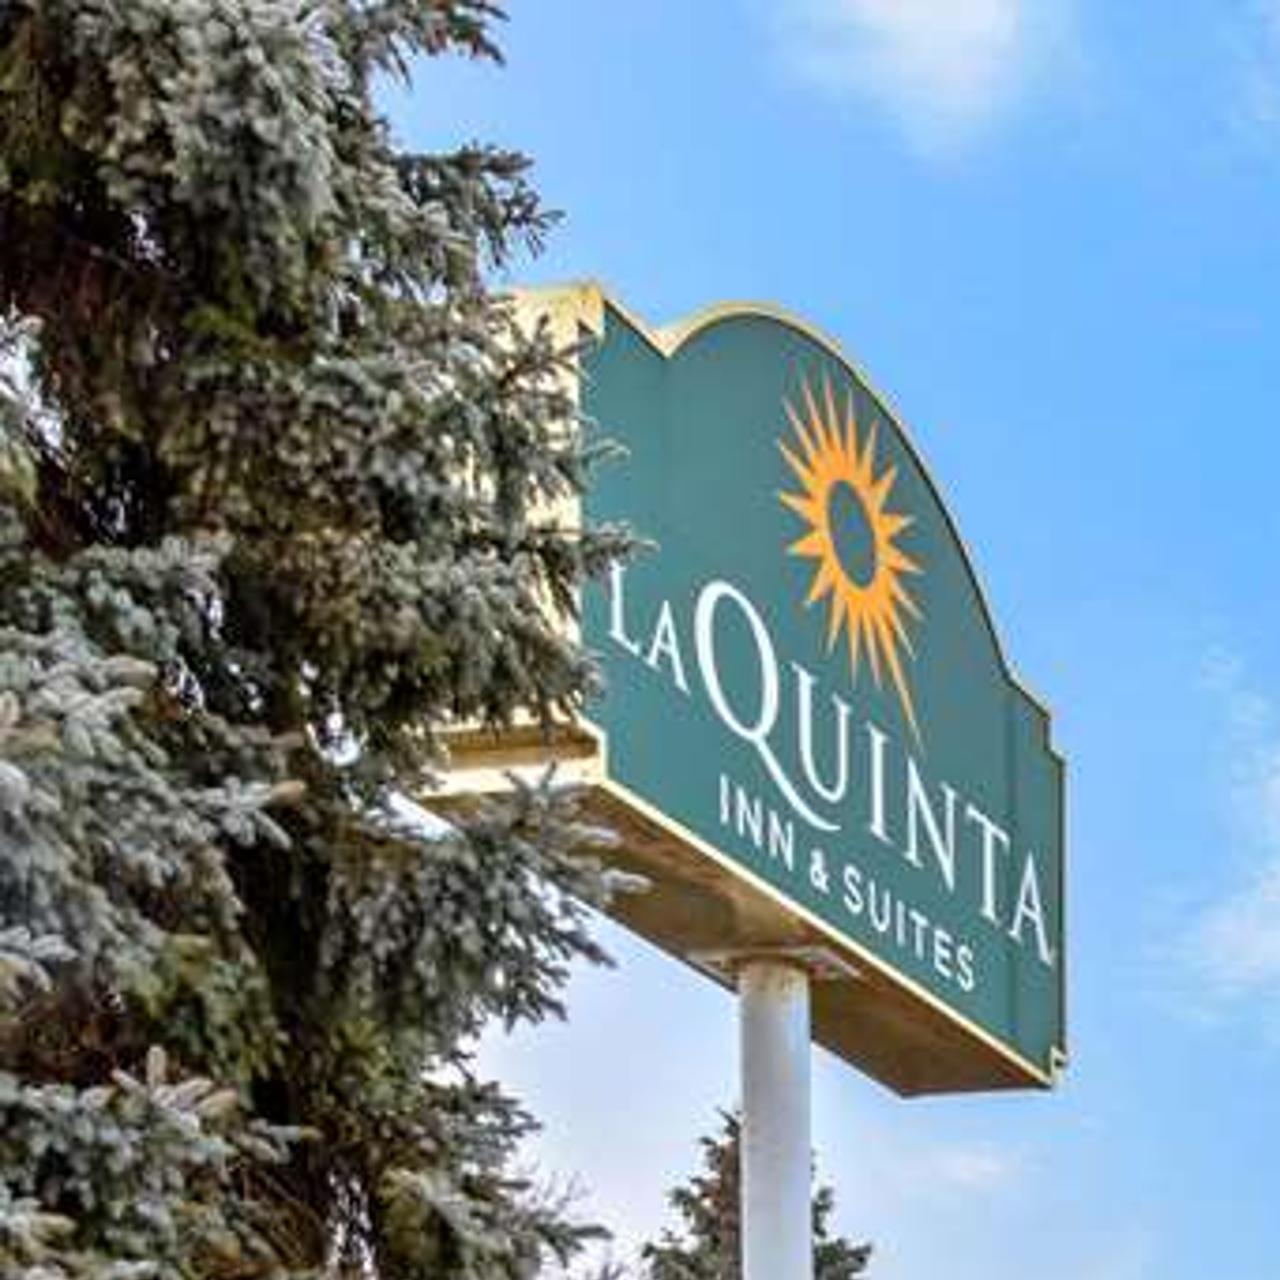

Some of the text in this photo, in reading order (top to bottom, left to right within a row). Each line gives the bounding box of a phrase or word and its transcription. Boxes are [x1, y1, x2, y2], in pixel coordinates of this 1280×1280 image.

[694, 580, 1053, 966] QUINTA
[719, 773, 975, 992] INN & SUITES
